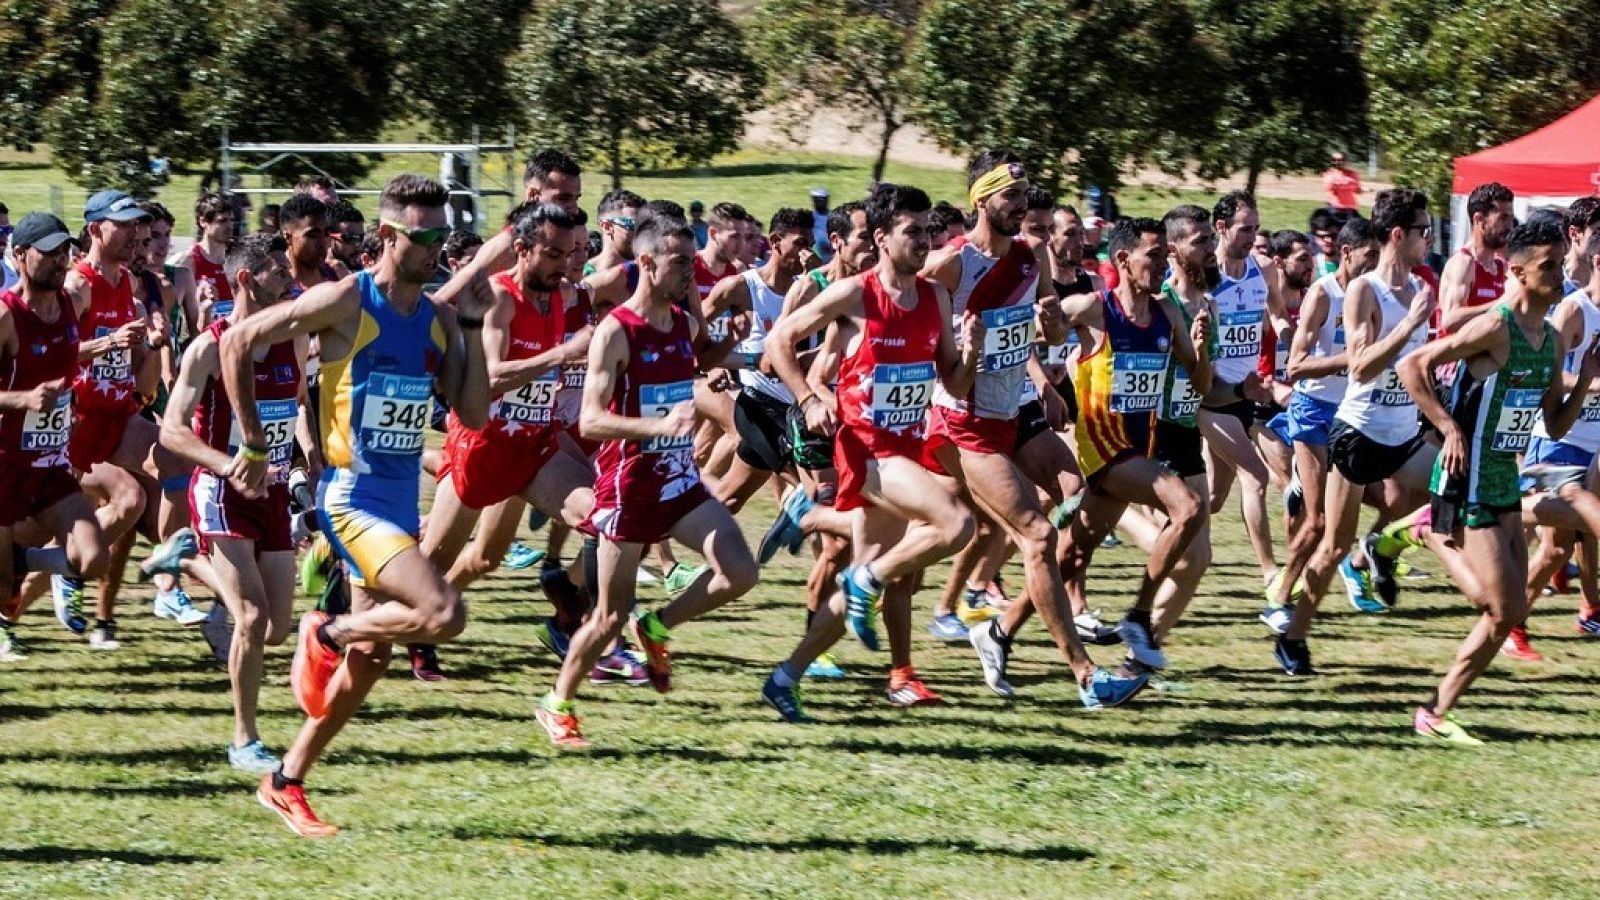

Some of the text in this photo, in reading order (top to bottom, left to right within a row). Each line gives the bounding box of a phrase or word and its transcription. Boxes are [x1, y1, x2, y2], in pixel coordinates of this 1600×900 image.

[996, 322, 1030, 351] 367
[1225, 325, 1257, 343] 406
[102, 349, 127, 365] 43
[1124, 372, 1160, 393] 381
[886, 384, 926, 408] 432
[1375, 392, 1411, 405] Jom
[378, 401, 428, 429] 348
[505, 405, 551, 421] Joma
[1508, 410, 1538, 432] 32
[263, 421, 289, 445] 65
[367, 431, 424, 450] Joma
